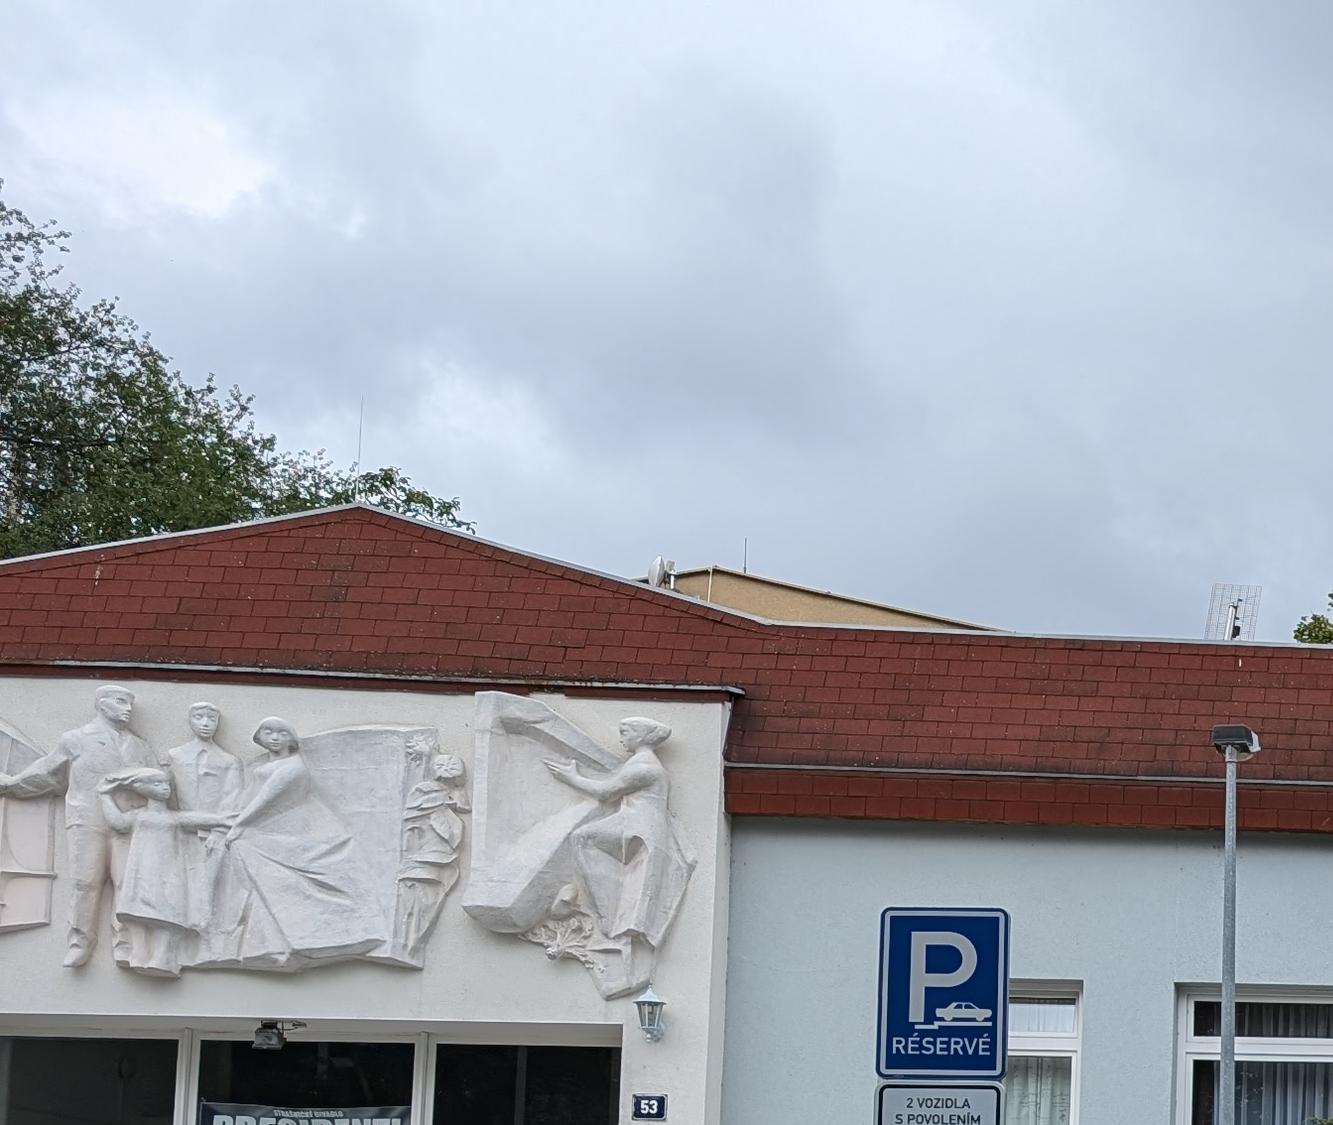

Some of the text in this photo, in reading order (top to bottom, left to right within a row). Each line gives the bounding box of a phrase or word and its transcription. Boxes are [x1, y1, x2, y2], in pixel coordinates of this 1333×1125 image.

[908, 931, 978, 1023] P
[892, 1032, 991, 1056] RÉSERVÉ
[640, 1099, 658, 1114] 53
[906, 1096, 971, 1110] 2 VOZIDLA
[895, 1112, 982, 1125] S POVOLENÍM
